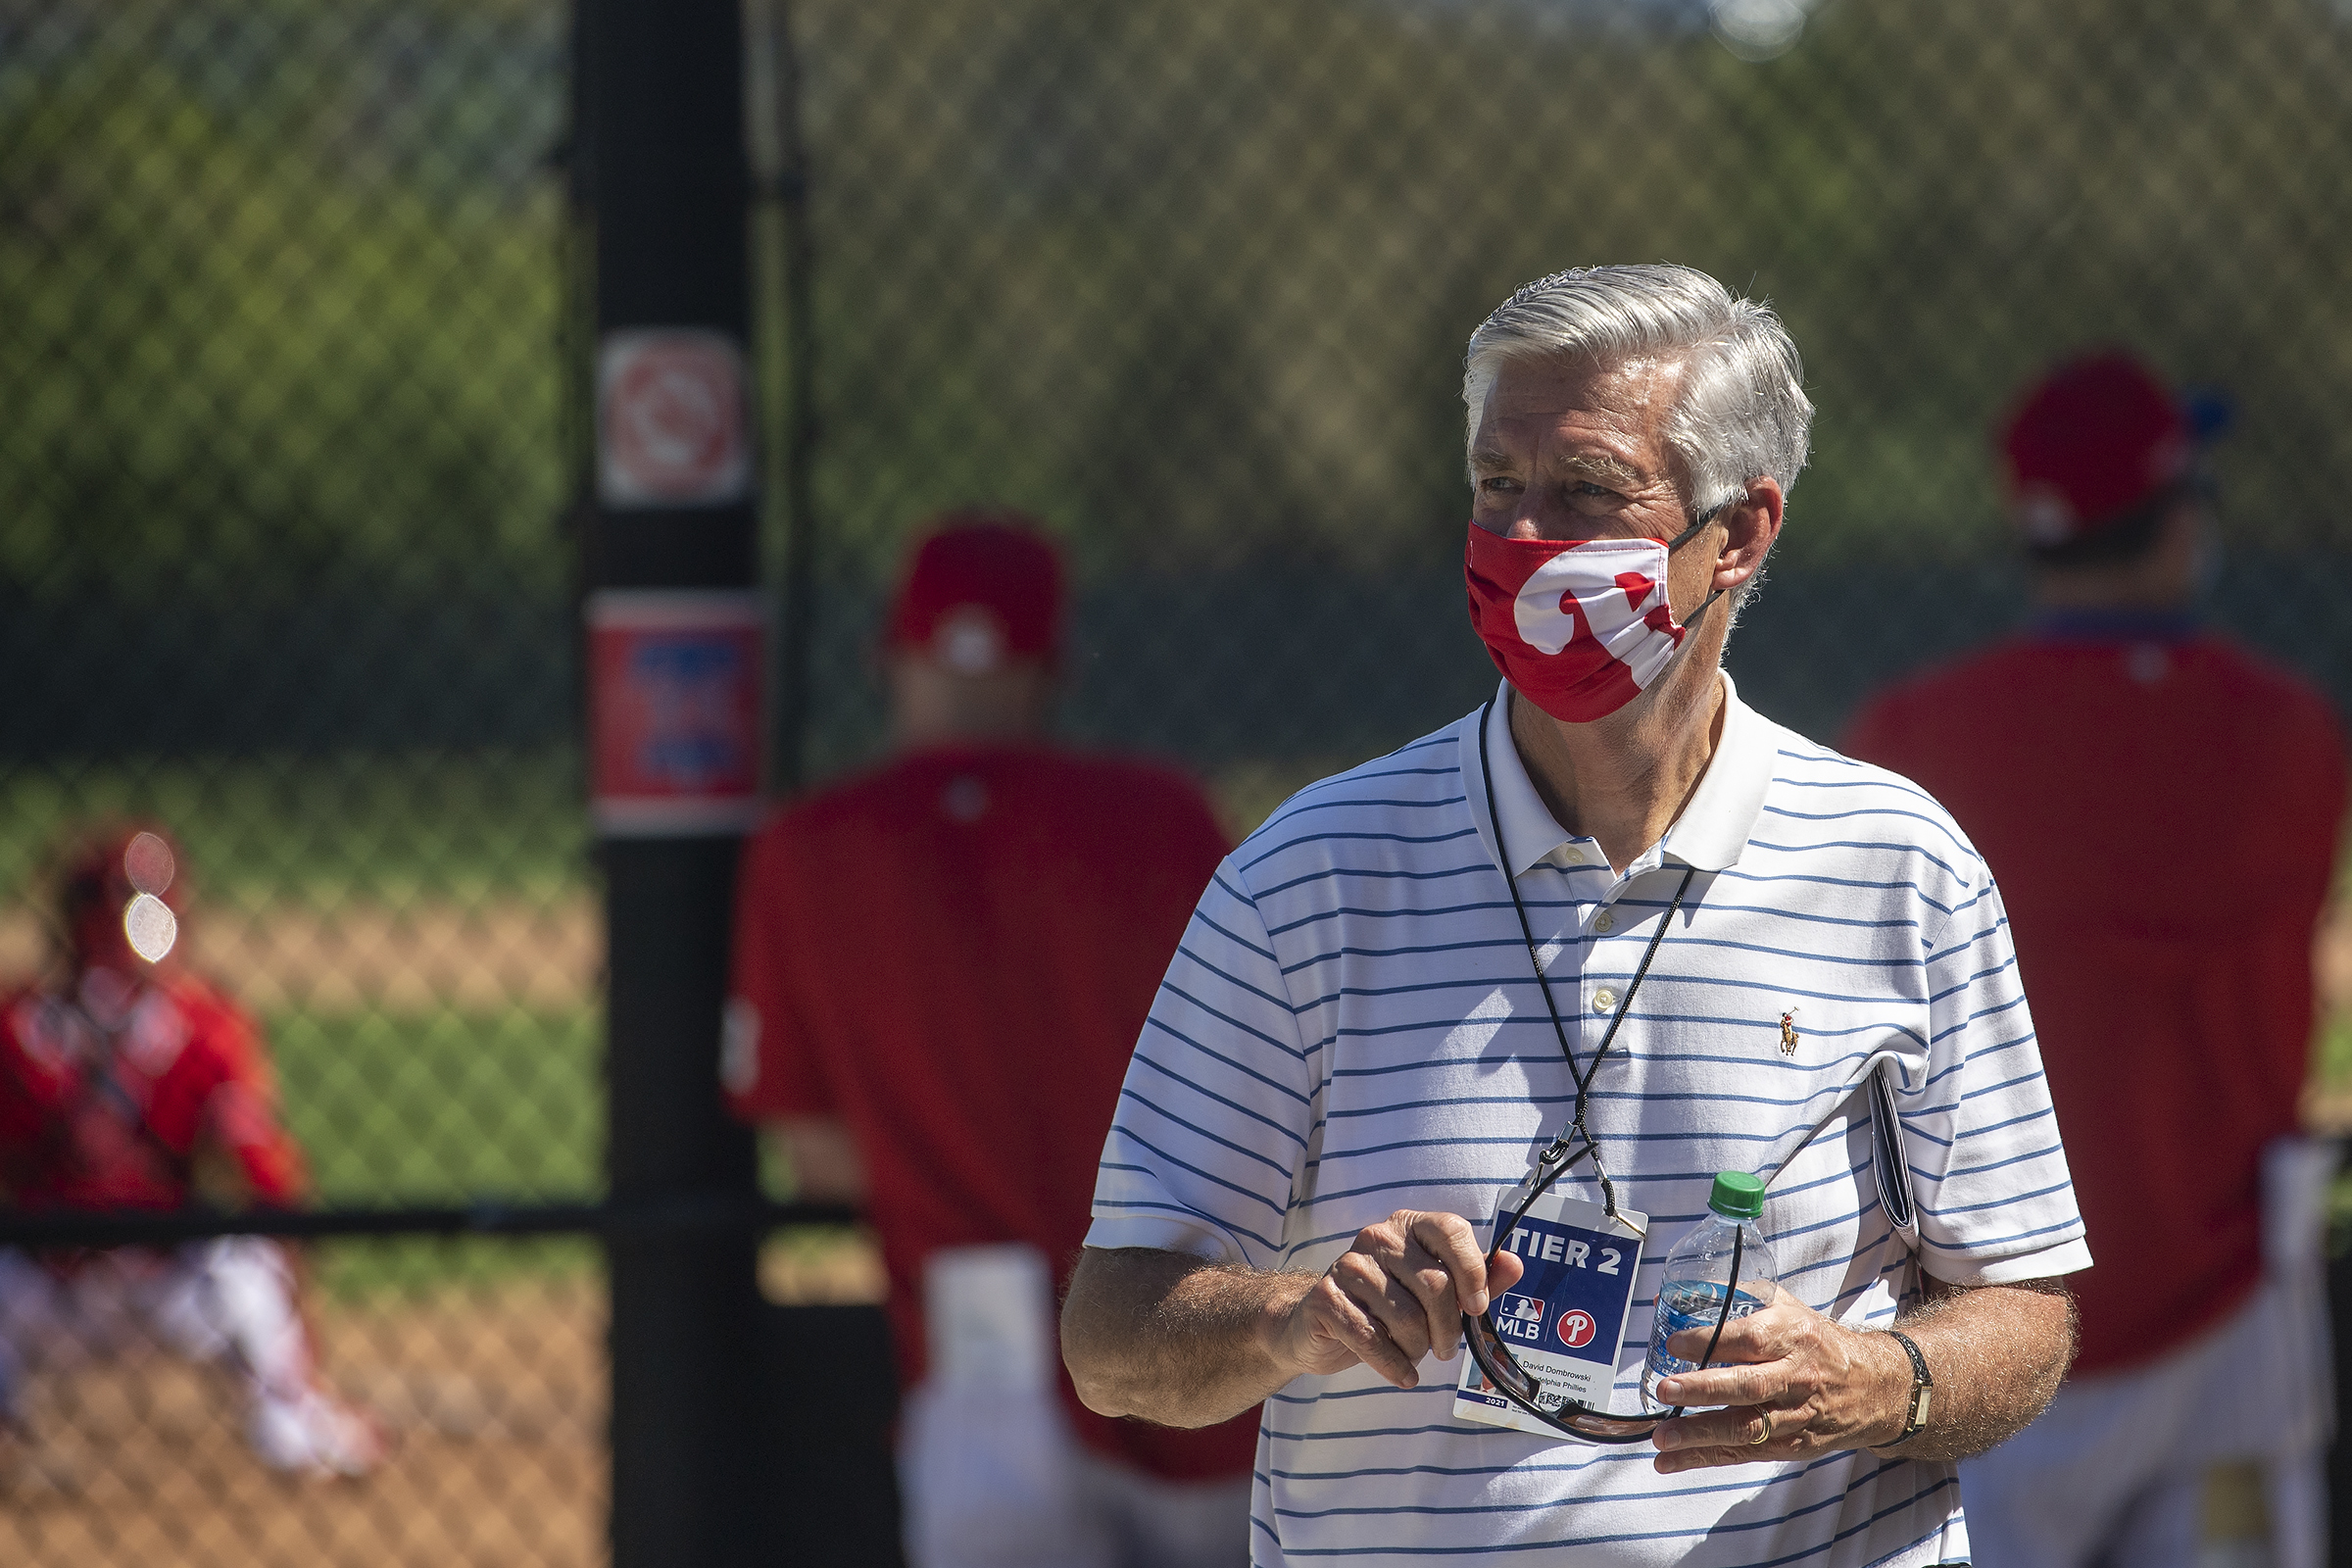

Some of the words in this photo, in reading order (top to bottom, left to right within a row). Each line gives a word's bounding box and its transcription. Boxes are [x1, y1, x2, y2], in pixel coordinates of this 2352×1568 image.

[1509, 1227, 1591, 1269] TIER
[1596, 1248, 1622, 1276] 2
[1495, 1316, 1540, 1341] MLB
[1566, 1314, 1589, 1343] P
[1523, 1360, 1544, 1372] David
[1545, 1365, 1592, 1382] Dombrowski
[1562, 1381, 1587, 1393] Phillies
[1485, 1396, 1505, 1407] 2021
